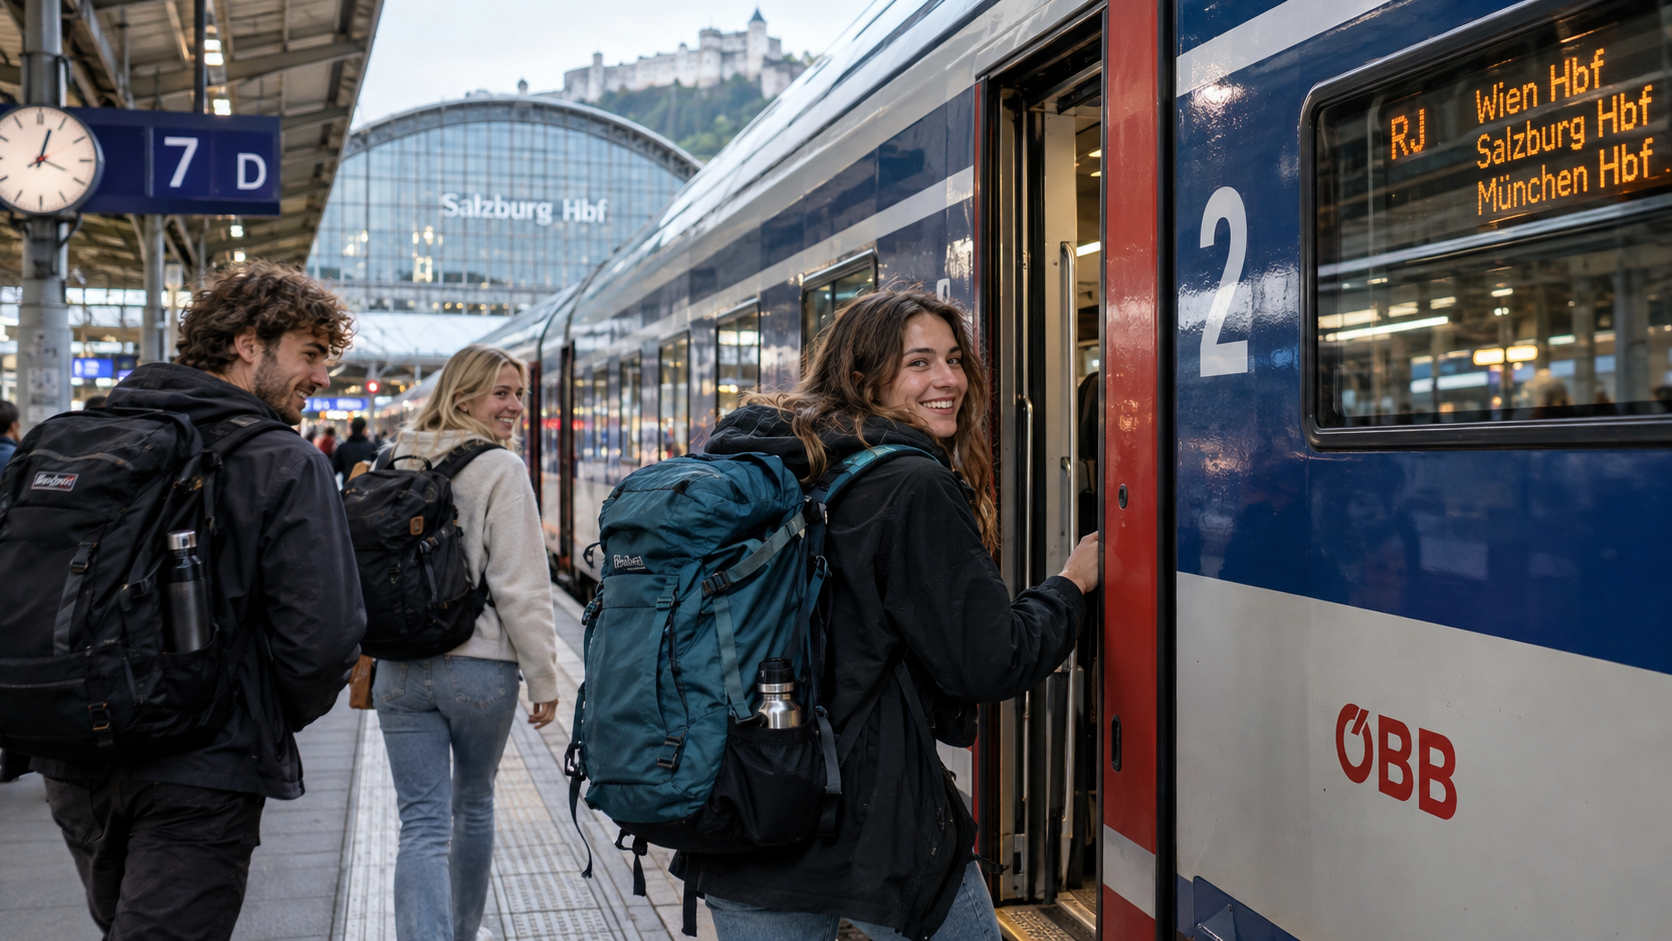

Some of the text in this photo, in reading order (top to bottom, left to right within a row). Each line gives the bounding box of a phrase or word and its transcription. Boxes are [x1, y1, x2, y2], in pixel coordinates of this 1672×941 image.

[1475, 48, 1605, 124] Wien Hbf
[164, 136, 267, 190] 7 D
[1391, 108, 1425, 160] RJ
[1477, 84, 1653, 169] Salzburg Hbf
[442, 193, 608, 226] Salzburg Hbf
[1477, 137, 1654, 216] München Hbf
[1199, 186, 1249, 378] 2
